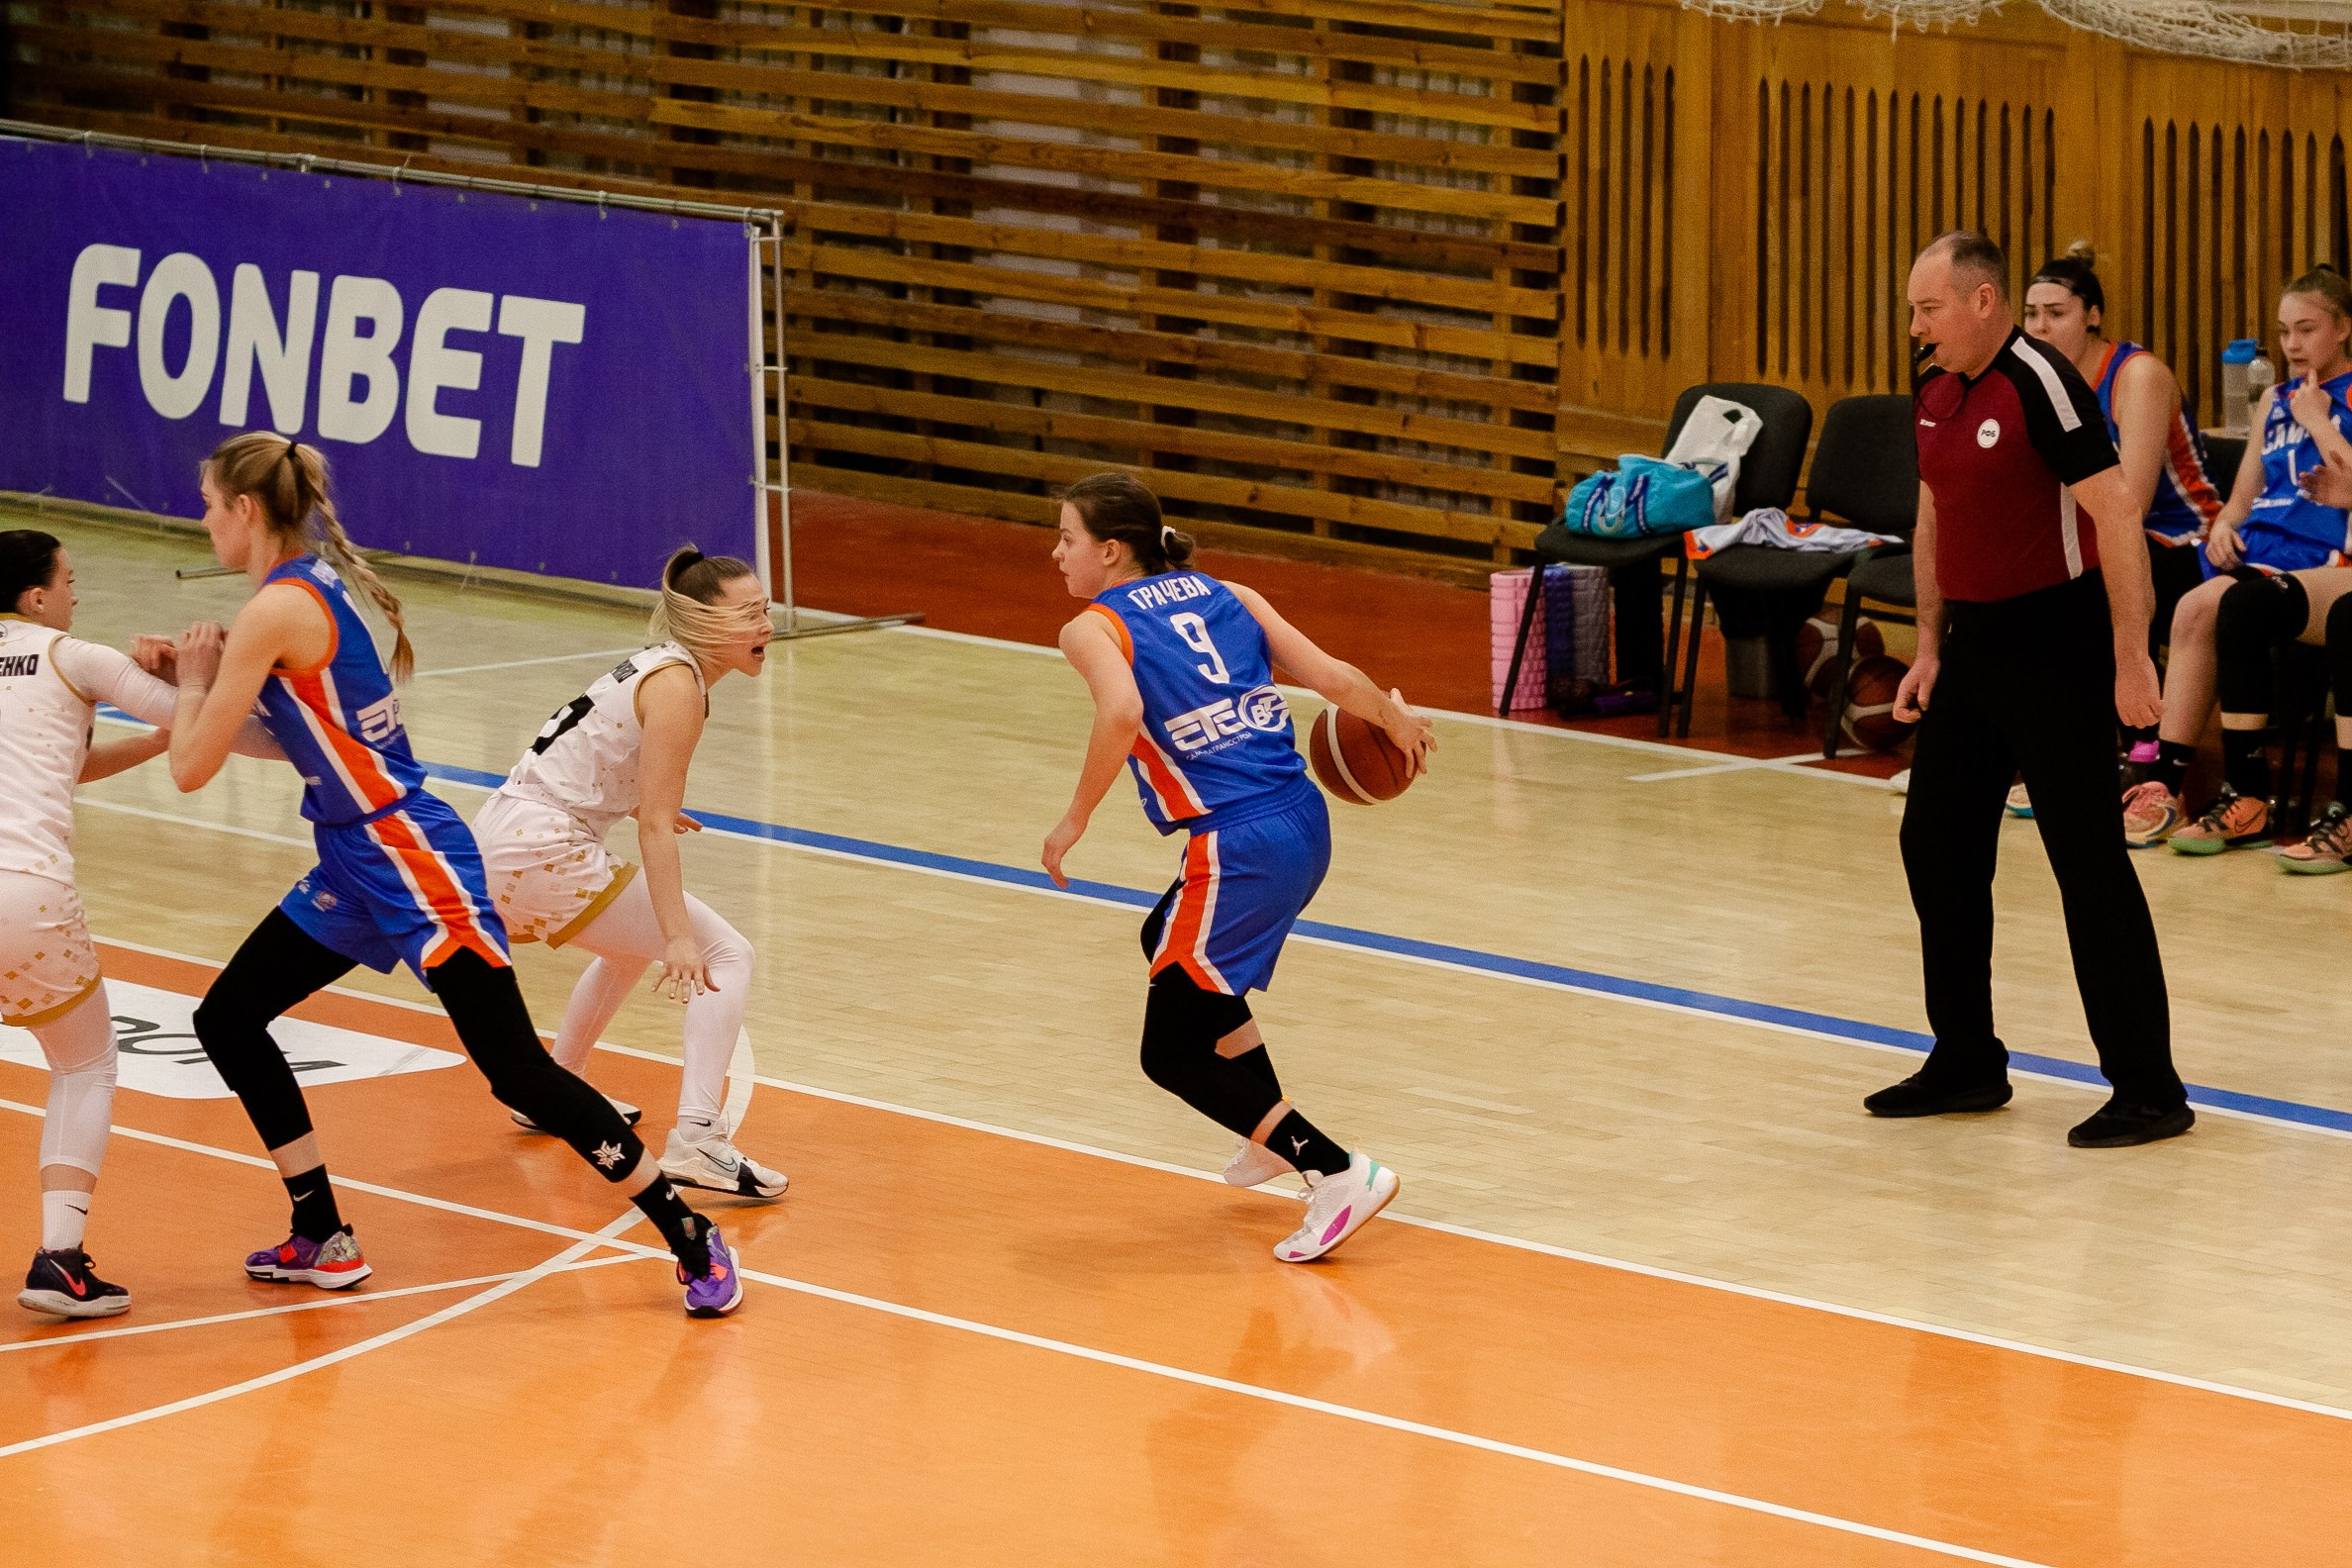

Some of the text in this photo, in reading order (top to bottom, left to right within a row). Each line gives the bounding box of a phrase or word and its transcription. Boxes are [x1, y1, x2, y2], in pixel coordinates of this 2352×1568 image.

[63, 244, 586, 468] FONBET
[1127, 575, 1211, 610] ГРАЧЕВА
[1170, 612, 1229, 684] 9
